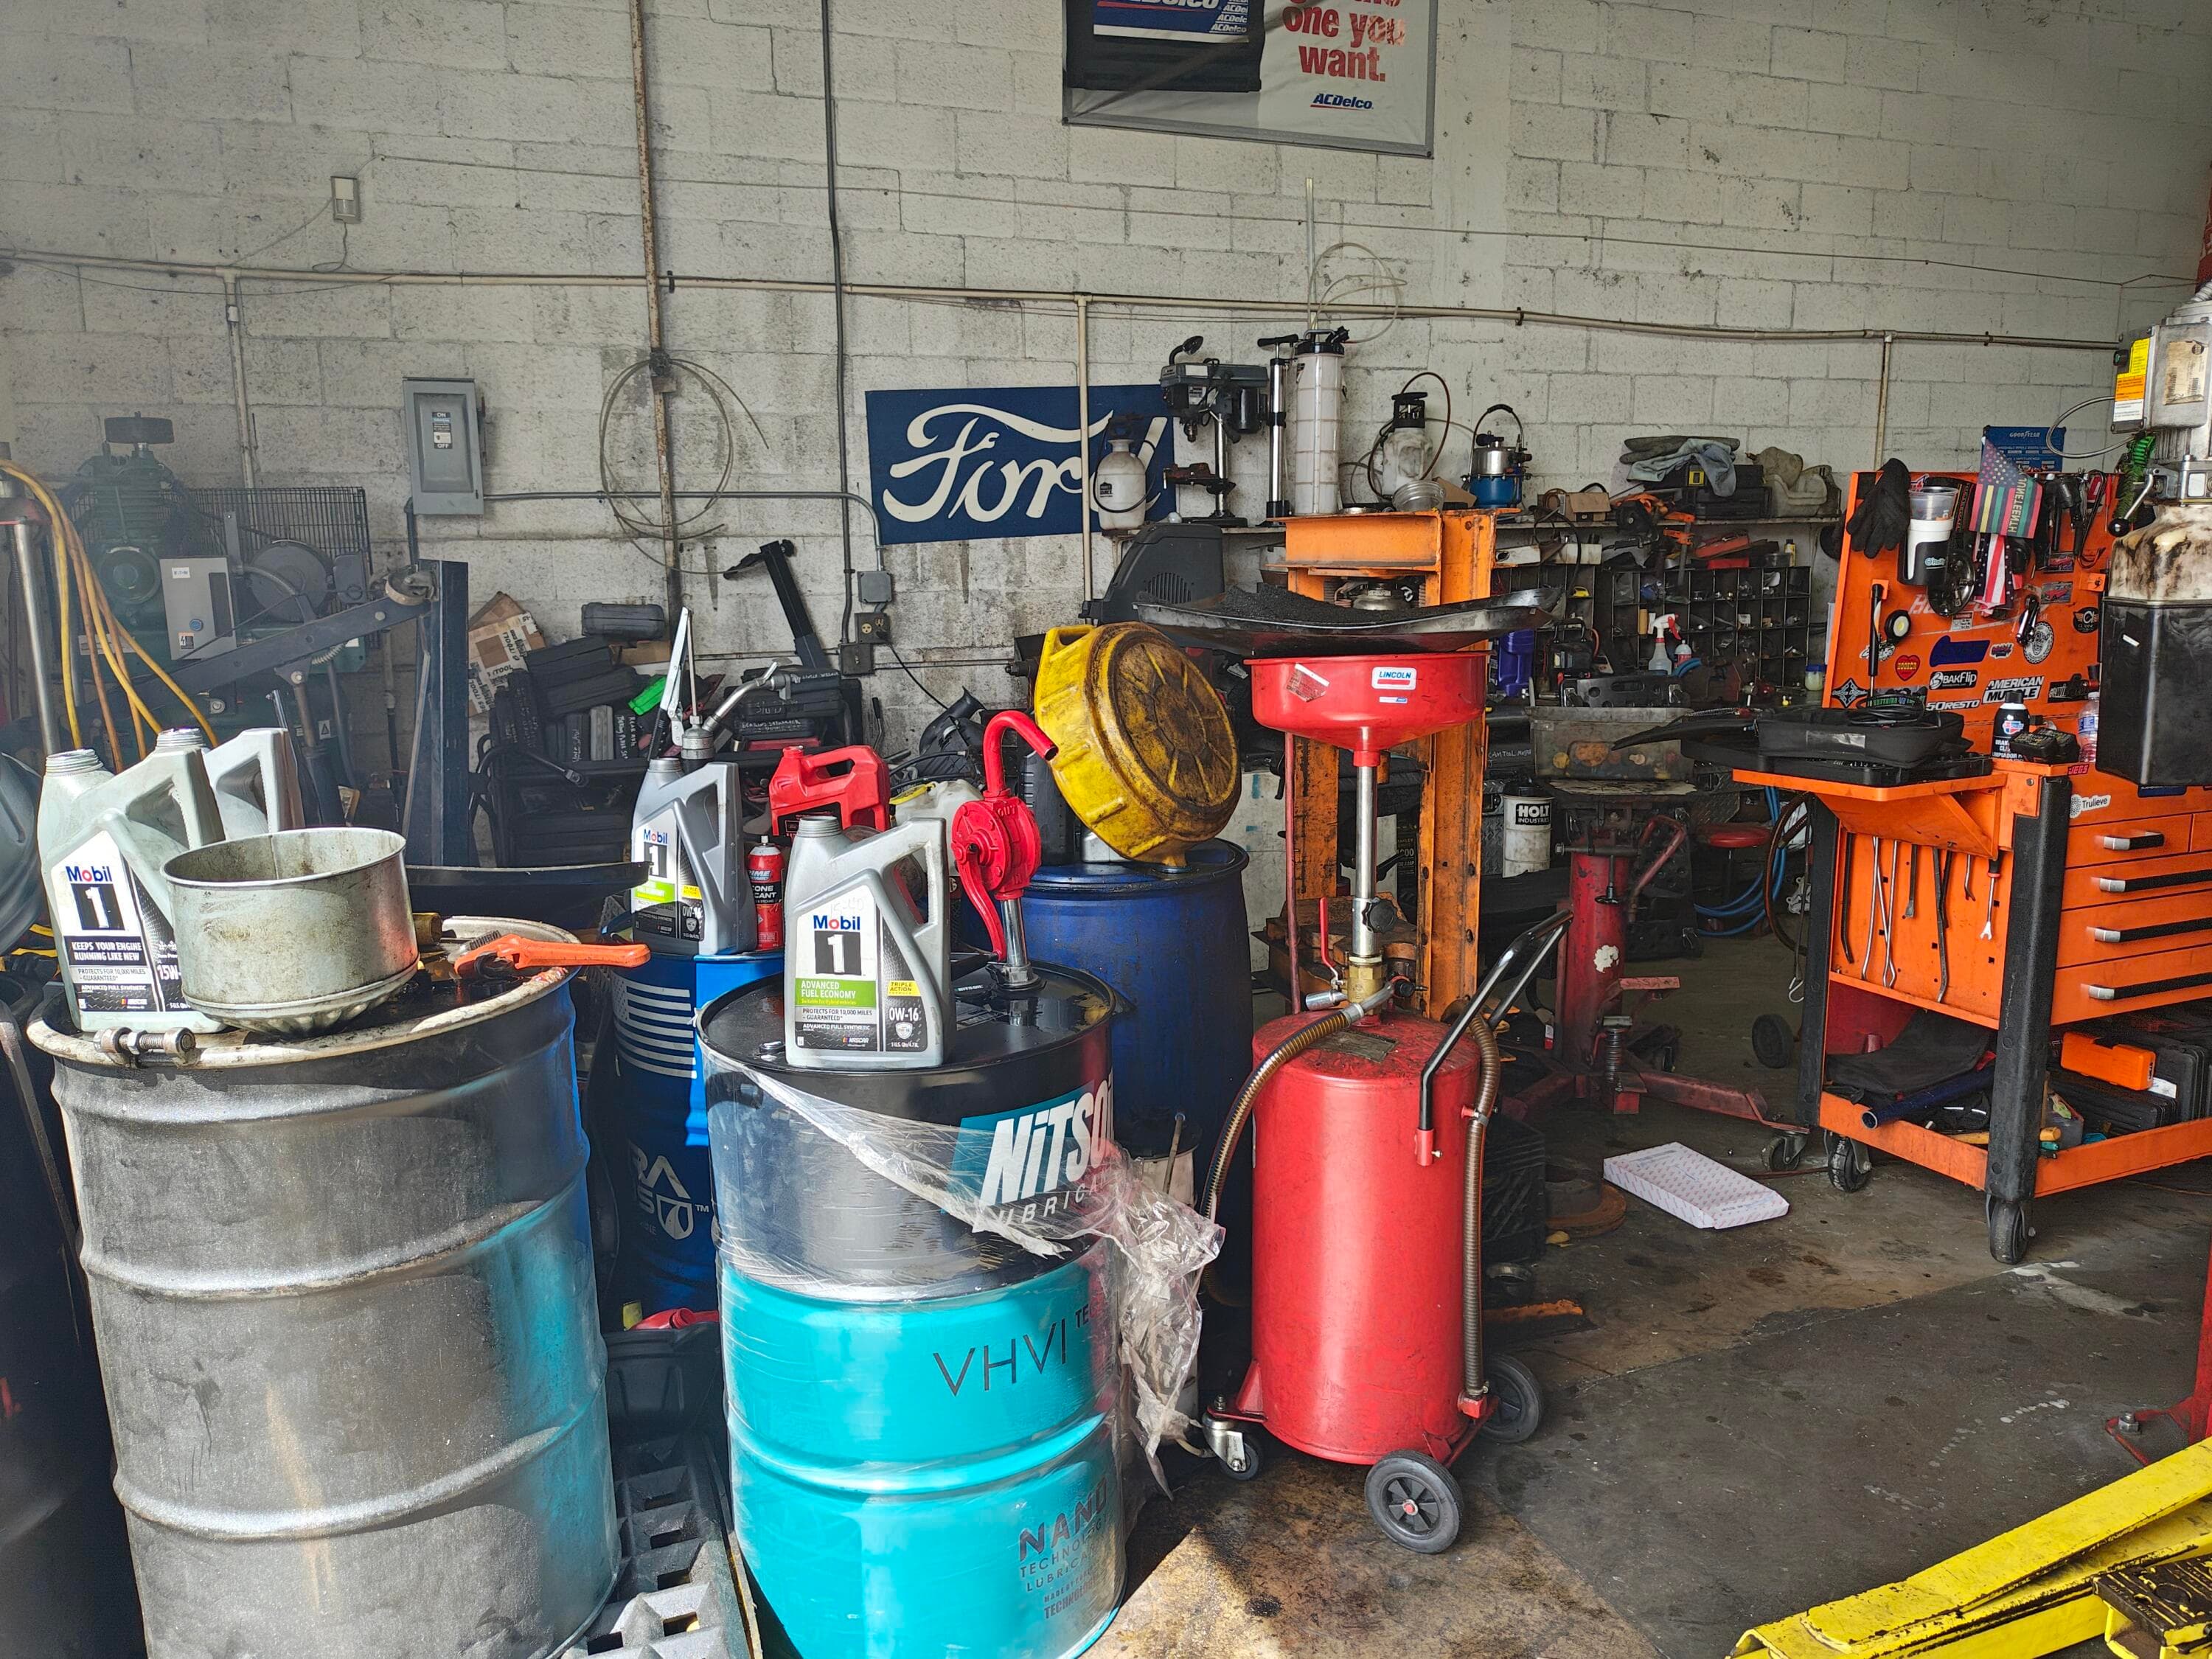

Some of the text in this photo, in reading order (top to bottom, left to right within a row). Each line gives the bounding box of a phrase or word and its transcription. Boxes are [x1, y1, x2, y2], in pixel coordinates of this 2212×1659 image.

[1211, 24, 1247, 32] ACDelco
[1283, 6, 1405, 48] one you
[1299, 46, 1385, 82] want.
[1313, 94, 1373, 109] ACDelco
[1986, 676, 2043, 689] AMERICAN
[1987, 689, 2036, 702] MULE
[2070, 765, 2088, 774] JEGS
[2082, 797, 2107, 810] Trulieve
[1518, 805, 1549, 818] HOLT
[644, 829, 667, 844] Mobil
[649, 846, 659, 876] 1
[66, 866, 112, 883] Mobil
[85, 886, 109, 928] 1
[813, 915, 860, 931] Mobil
[72, 942, 142, 951] KEEPS YOUR ENGINE
[827, 934, 845, 973] 1
[74, 952, 139, 961] RUNNING LIKE NEW
[801, 981, 839, 990] ADVANCED
[801, 990, 856, 999] FUEL ECONOMY
[889, 1007, 919, 1021] 0W-16
[933, 1318, 1067, 1396] VHVI
